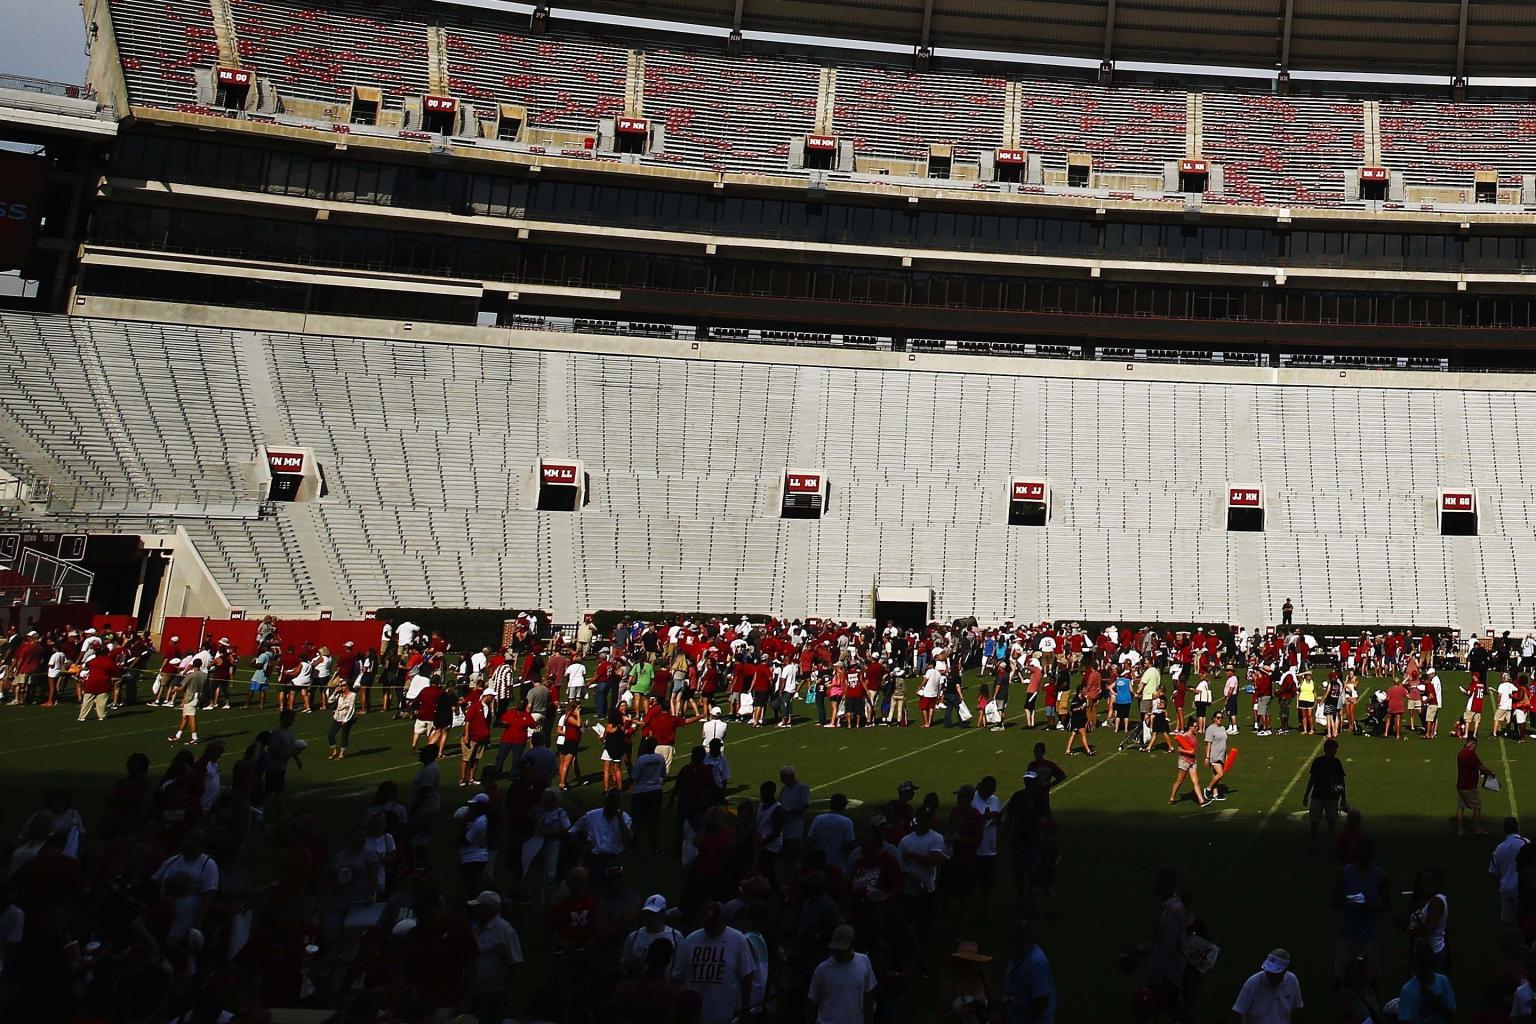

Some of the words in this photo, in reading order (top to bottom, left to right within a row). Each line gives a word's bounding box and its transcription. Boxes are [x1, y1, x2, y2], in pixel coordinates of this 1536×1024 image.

[283, 457, 301, 466] MM
[544, 469, 560, 477] MM
[561, 470, 572, 478] LL
[1031, 484, 1041, 495] JJ
[1477, 689, 1484, 699] 16
[570, 910, 589, 928] M
[691, 947, 725, 963] ROLL
[691, 964, 725, 980] TIDE
